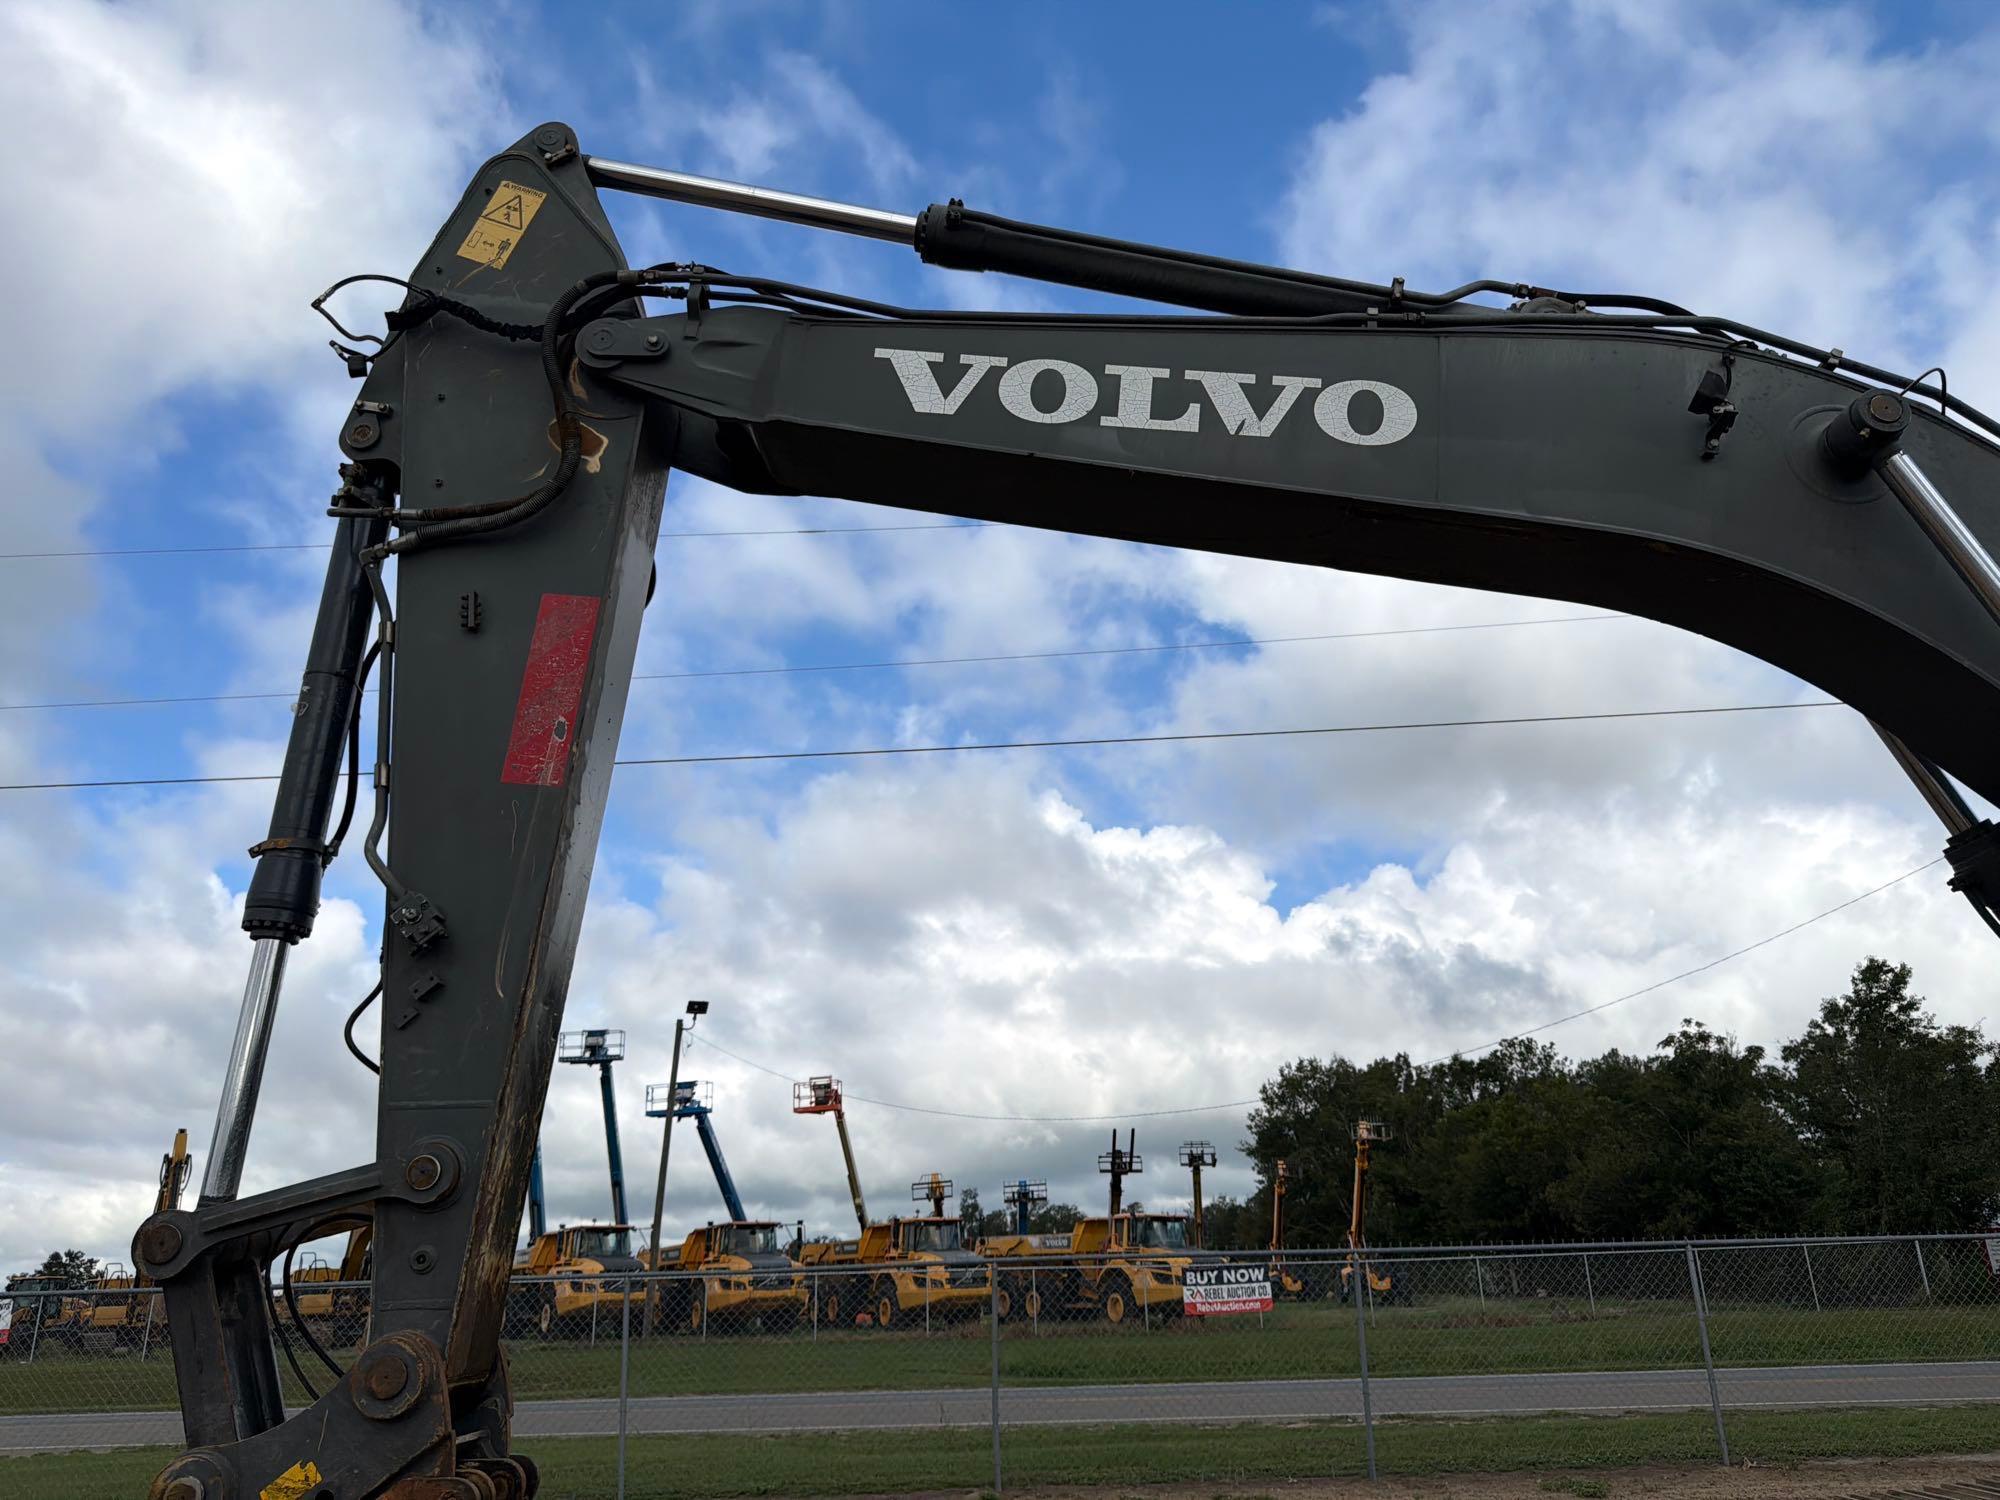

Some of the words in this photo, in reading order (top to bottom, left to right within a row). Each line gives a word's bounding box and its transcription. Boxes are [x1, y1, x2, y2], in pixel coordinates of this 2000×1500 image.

[511, 184, 544, 198] WARNING
[874, 347, 1418, 446] VOLVO
[1185, 1271, 1218, 1285] BUY
[1222, 1267, 1265, 1283] NOW
[1204, 1287, 1225, 1300] REBEL
[1226, 1285, 1256, 1299] AUCTION
